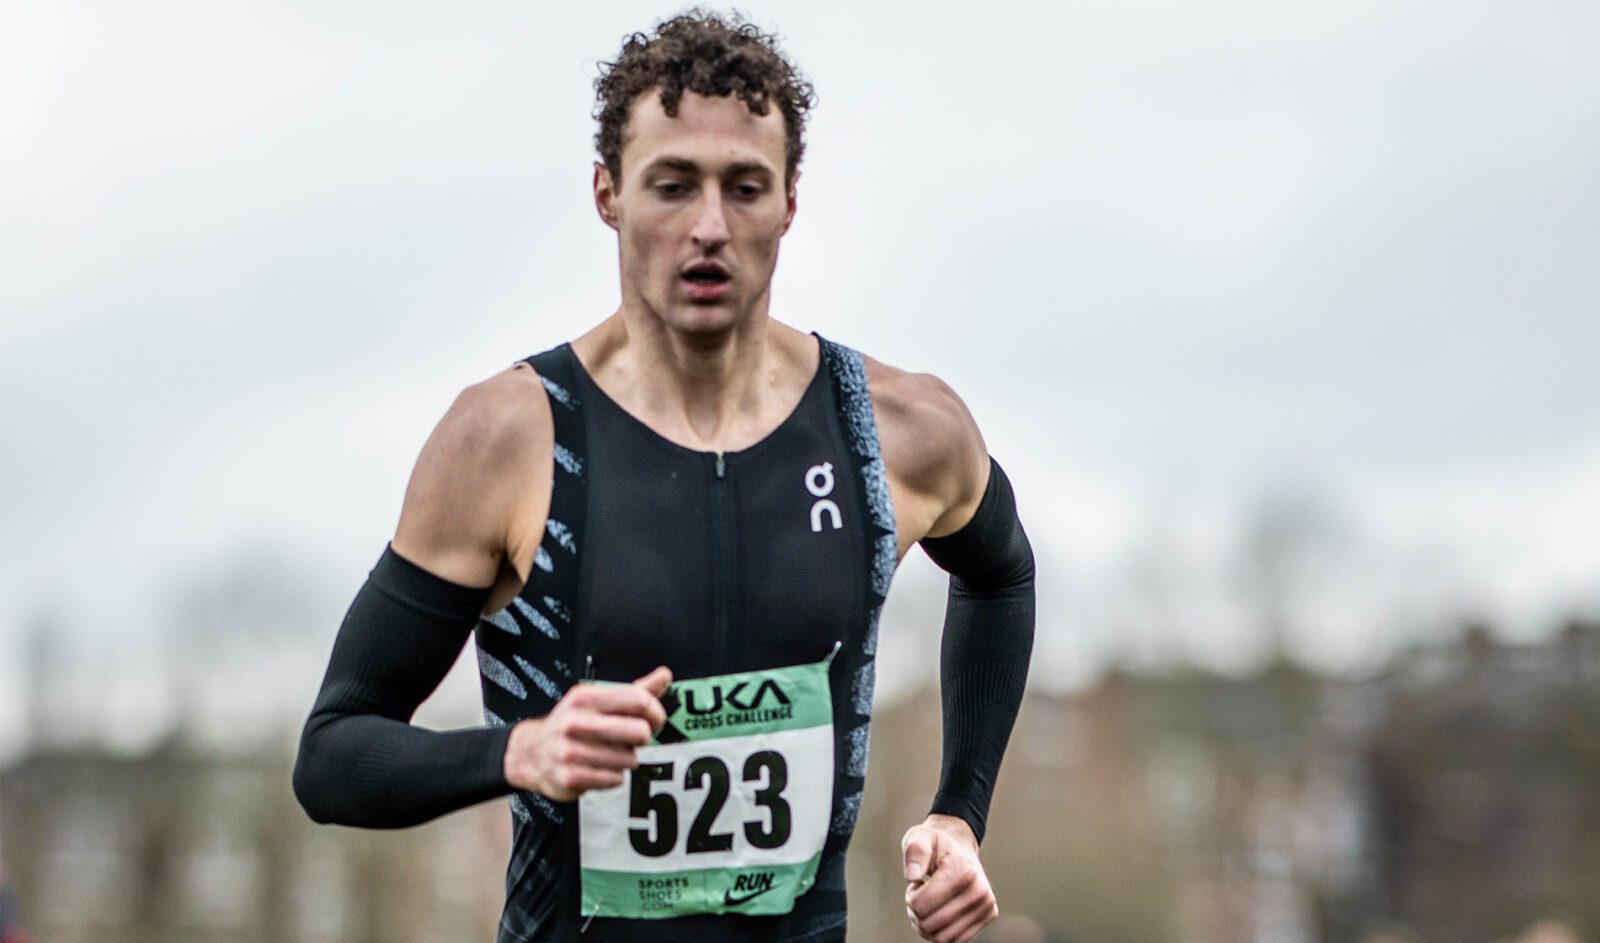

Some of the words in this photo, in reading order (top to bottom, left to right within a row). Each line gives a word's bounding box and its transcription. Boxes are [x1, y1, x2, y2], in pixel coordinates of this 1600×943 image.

[684, 716, 724, 731] CROSS
[726, 704, 794, 726] CHALLENGE
[628, 749, 792, 858] 523
[639, 877, 689, 889] SPORTS
[733, 871, 775, 891] RUN
